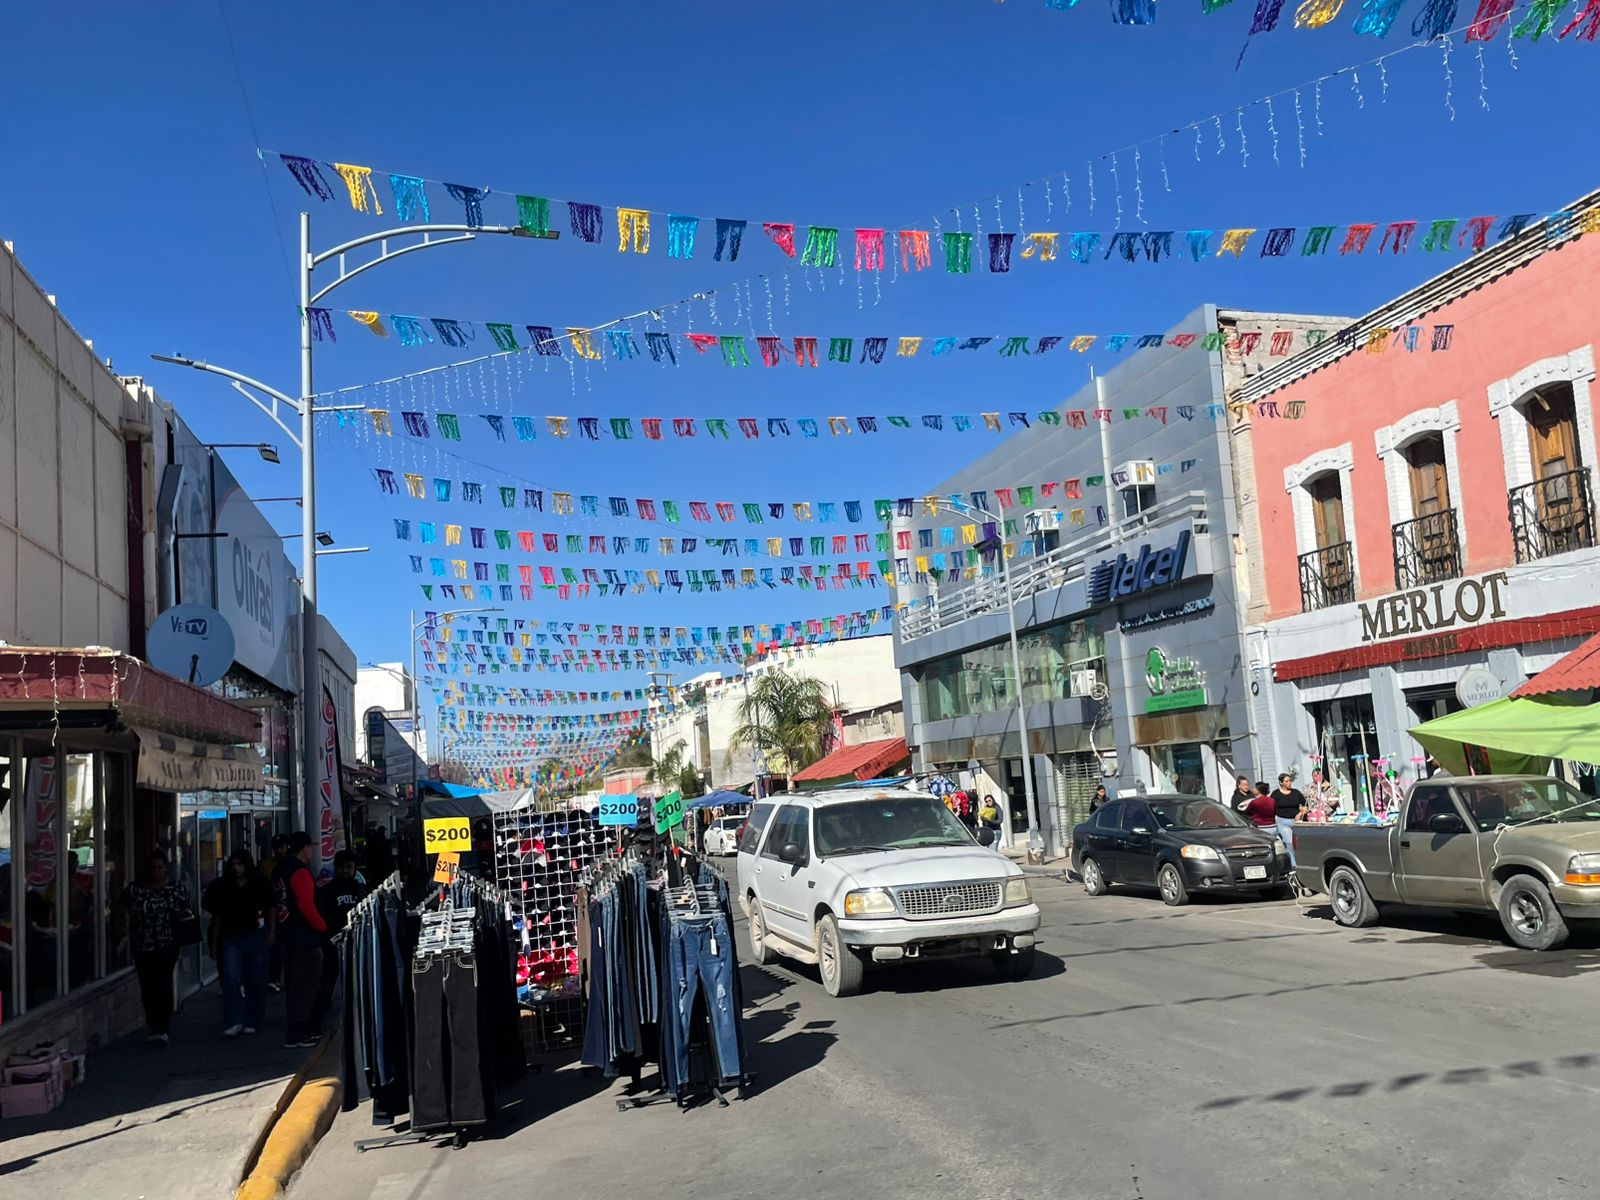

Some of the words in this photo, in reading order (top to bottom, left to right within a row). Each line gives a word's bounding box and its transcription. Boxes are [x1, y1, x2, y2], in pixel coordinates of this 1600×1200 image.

[1109, 529, 1191, 598] telcel
[233, 537, 272, 632] Olivas
[1358, 571, 1508, 642] MERLOT
[1467, 690, 1500, 701] MERLOT
[601, 803, 637, 815] $200
[656, 800, 682, 824] $200
[426, 828, 470, 842] $200
[437, 860, 457, 873] $2
[337, 895, 358, 906] POL
